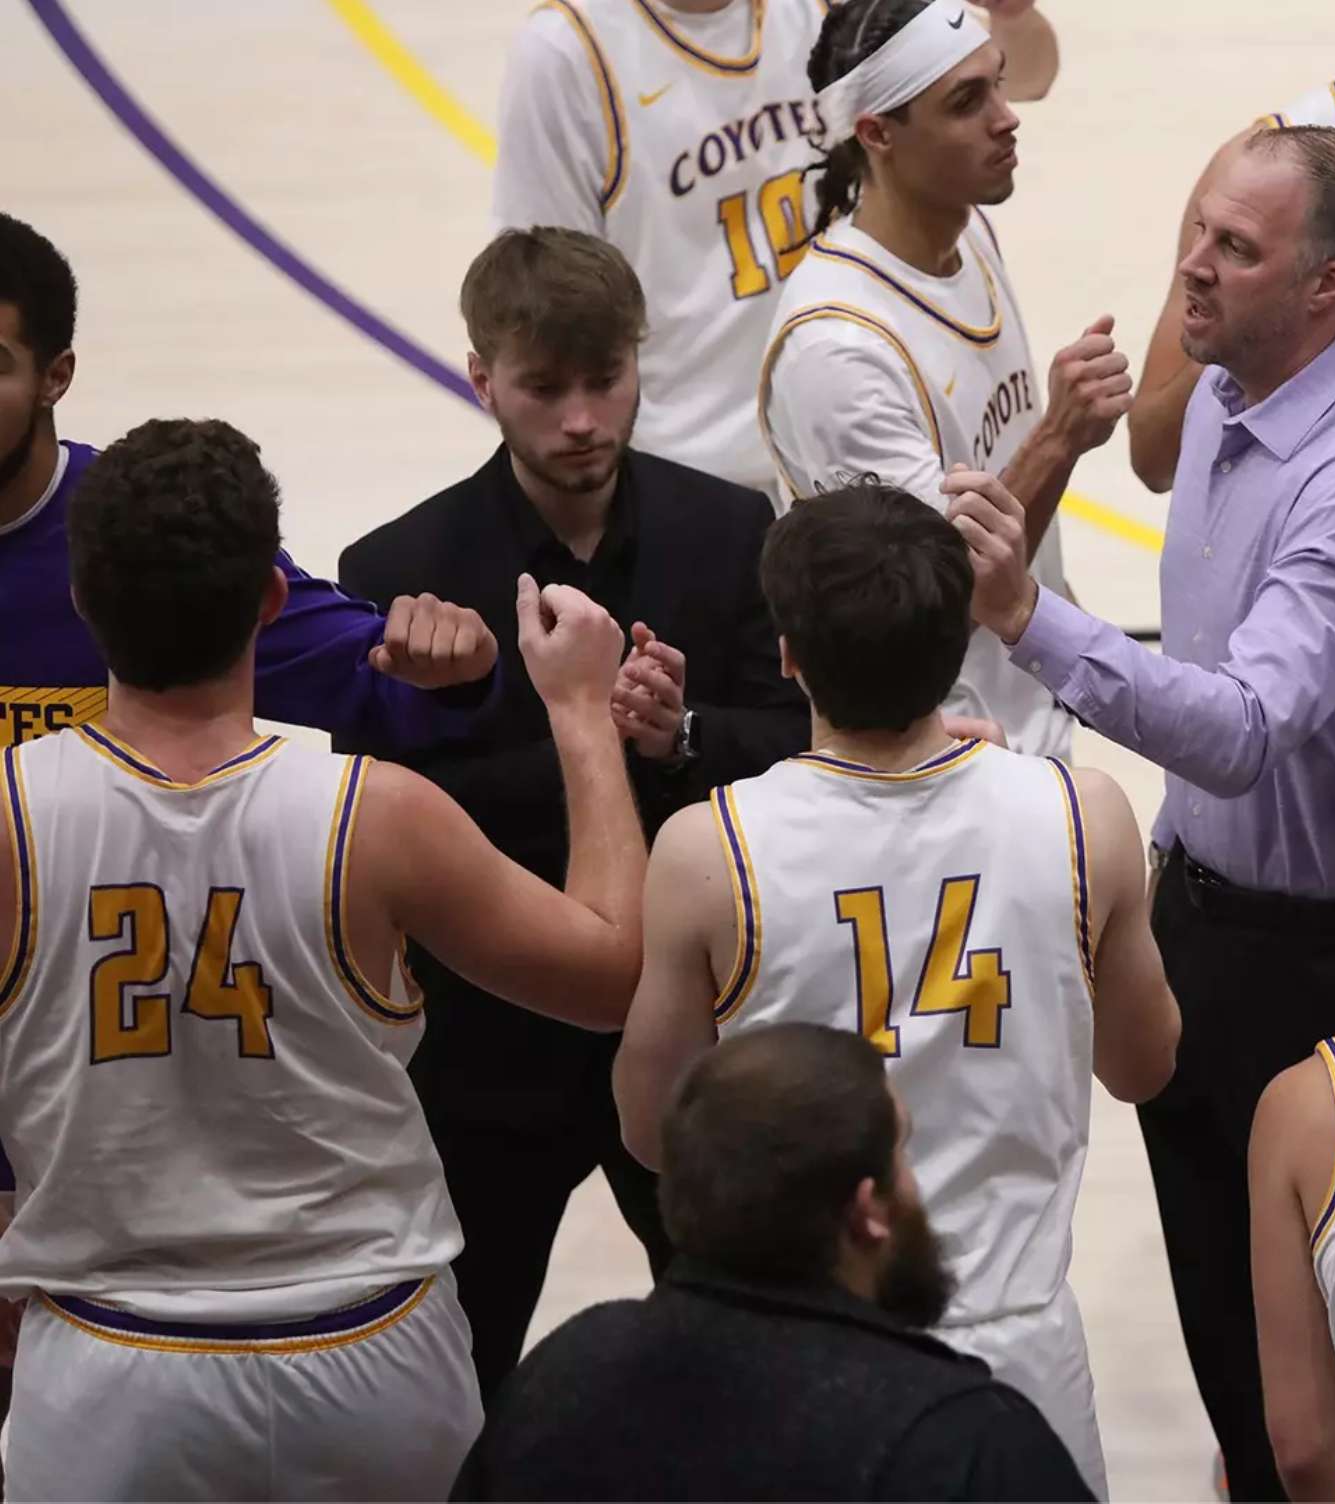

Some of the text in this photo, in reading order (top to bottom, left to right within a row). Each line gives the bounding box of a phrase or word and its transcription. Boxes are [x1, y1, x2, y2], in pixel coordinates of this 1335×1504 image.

[717, 168, 811, 300] 10
[89, 881, 276, 1066] 24
[833, 873, 1012, 1058] 14
